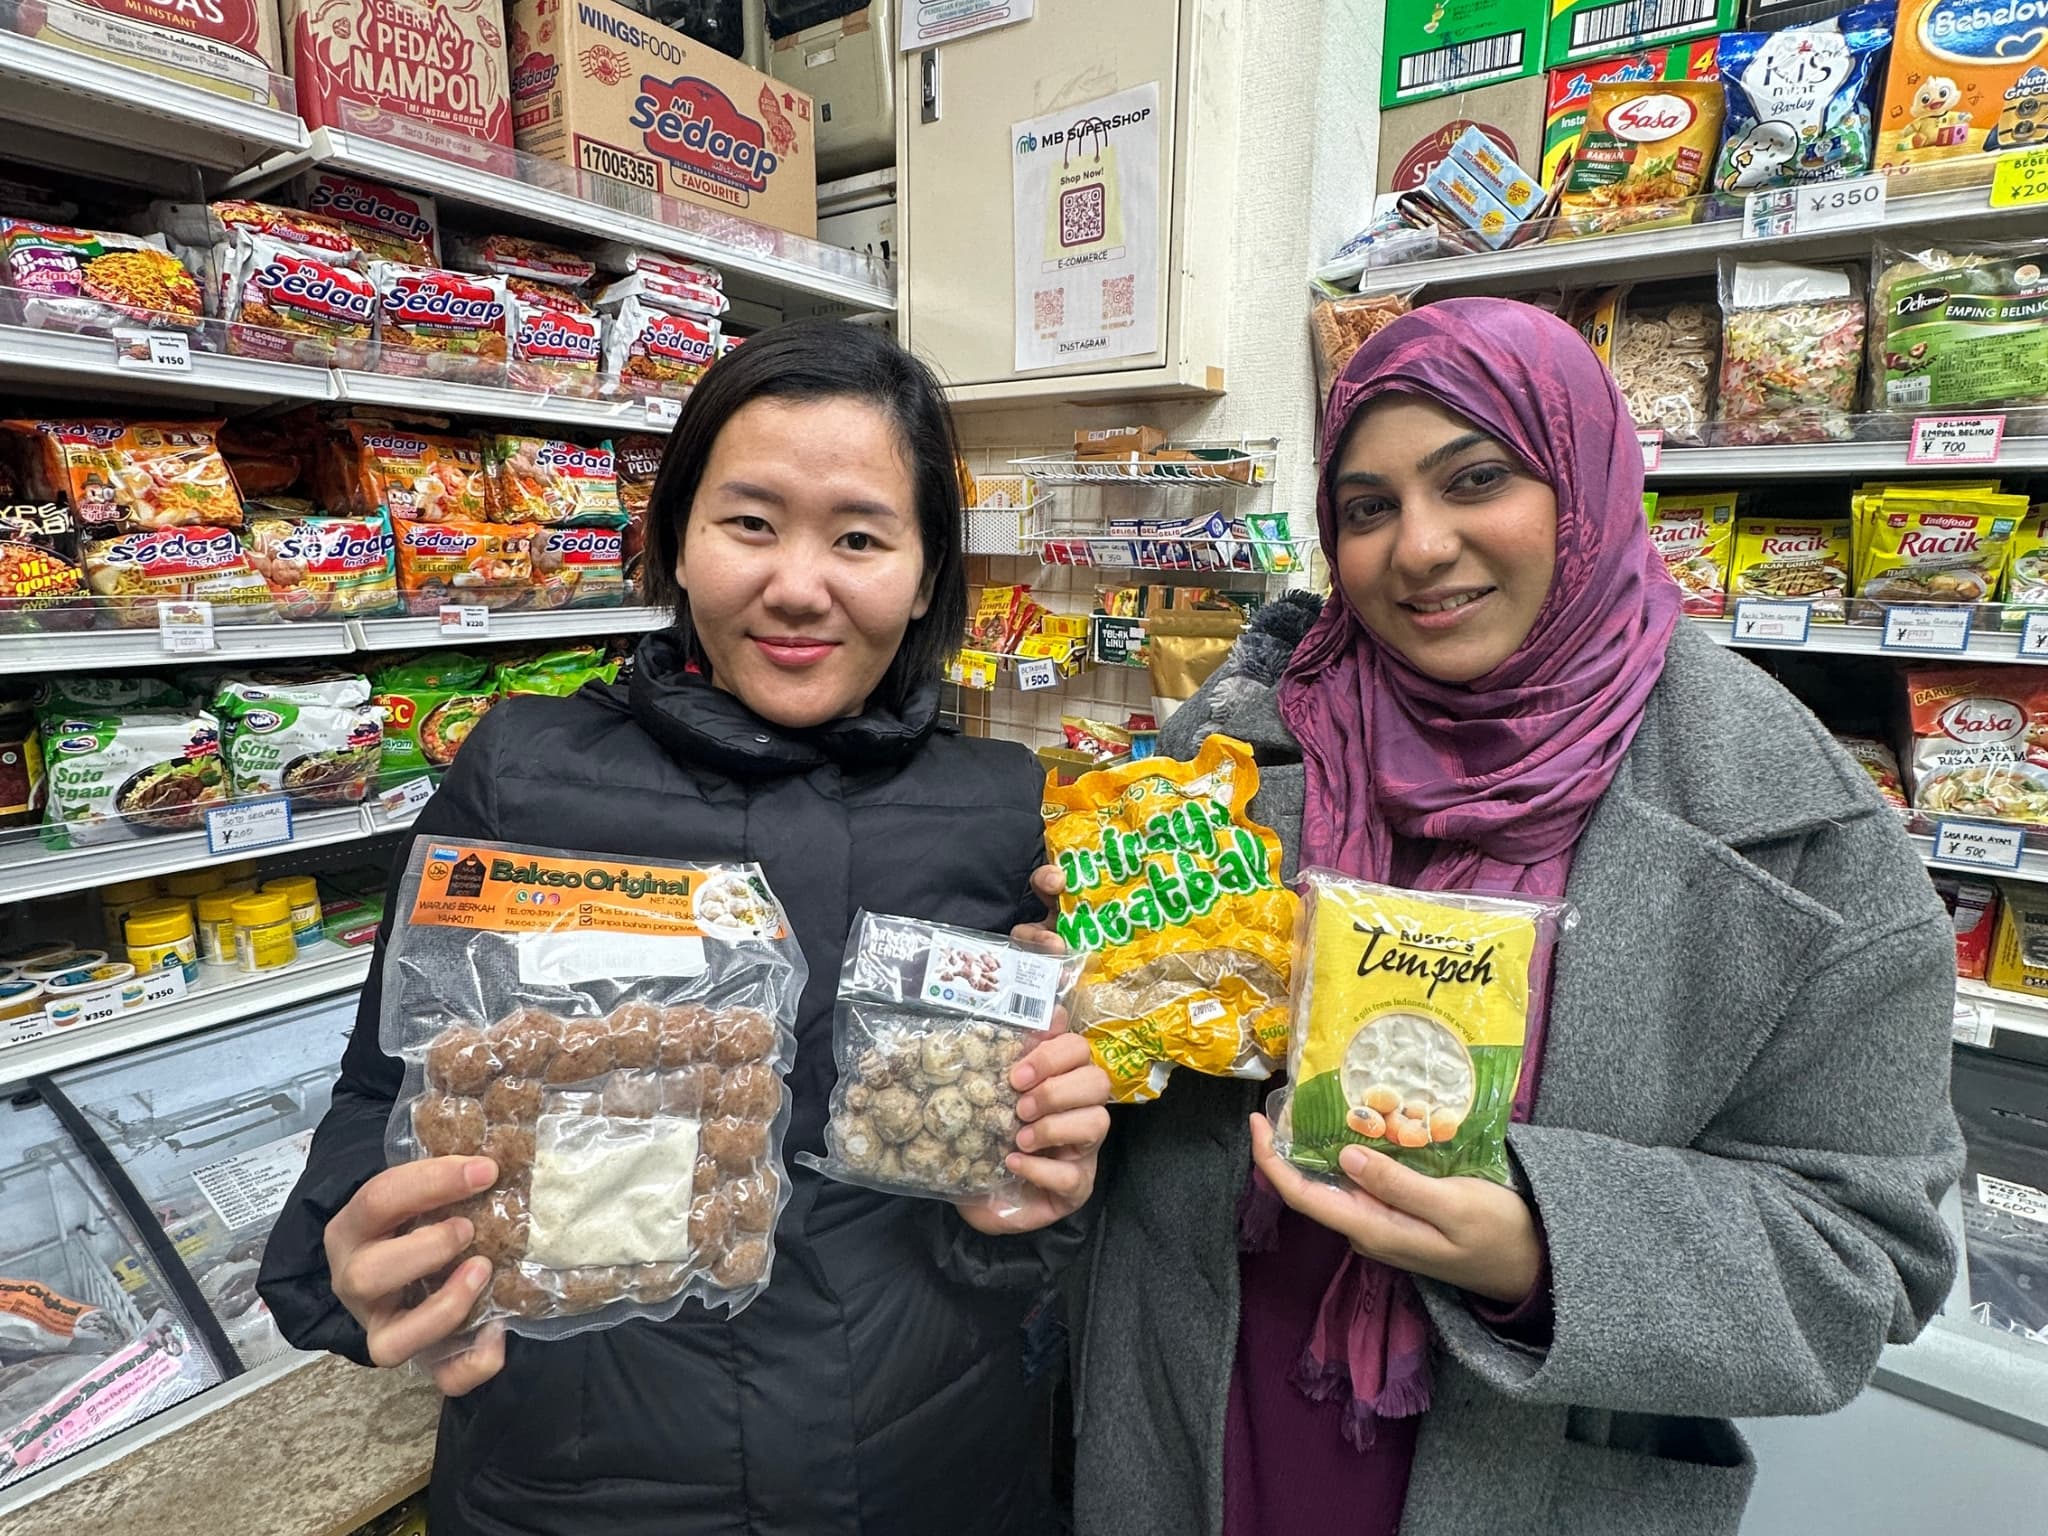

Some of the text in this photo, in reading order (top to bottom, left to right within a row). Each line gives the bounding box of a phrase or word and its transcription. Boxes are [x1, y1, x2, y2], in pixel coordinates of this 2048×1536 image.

[125, 0, 198, 29] MI INSTANT
[578, 3, 682, 65] WINGSFOOD
[377, 23, 455, 71] PEDAS
[353, 51, 485, 116] NAMPOL
[409, 104, 484, 127] MI INSTAN GORENG
[671, 97, 693, 117] Mi
[1618, 99, 1681, 131] Sasa
[1771, 97, 1815, 116] Barley
[630, 94, 778, 180] Sedaap
[1042, 132, 1064, 148] MB
[1586, 151, 1625, 160] BAKWAN
[2015, 158, 2048, 169] BEBE
[583, 143, 654, 188] 17005355
[1060, 167, 1105, 186] Shop Now!
[344, 186, 361, 197] Mi
[681, 173, 741, 203] FAVOURITE
[2011, 182, 2048, 200] ¥20
[311, 184, 432, 236] Sedaap
[1057, 251, 1109, 269] E-COMMERCE
[299, 266, 318, 280] Mi
[420, 283, 437, 295] Mi
[383, 284, 504, 329] Sedaap
[1945, 305, 1998, 319] EMPING
[541, 321, 554, 331] Mi
[642, 324, 715, 360] Sedaap
[1059, 338, 1107, 353] INSTAGRAM
[157, 355, 184, 366] ¥150
[362, 434, 428, 453] Sedaap
[1942, 441, 1966, 453] 700
[1924, 516, 1974, 528] Indofood
[278, 532, 394, 561] Sedaap
[403, 532, 477, 550] Sedaap
[1761, 537, 1830, 555] Racik
[1897, 531, 1983, 557] Racik
[1759, 560, 1783, 569] IKAN
[1031, 674, 1050, 686] 500
[1915, 686, 1953, 705] BARU!
[1954, 704, 2015, 734] Sasa
[238, 739, 280, 760] Soto
[1937, 751, 2027, 766] RASA AYAM
[57, 767, 104, 784] Soto
[1965, 846, 1986, 858] 500
[489, 858, 584, 891] Bakso
[583, 872, 690, 900] Original
[457, 902, 496, 914] BERKAH
[594, 918, 621, 928] tanpa
[1353, 920, 1497, 999] Tempeh
[147, 987, 174, 1001] ¥350
[84, 1008, 113, 1022] ¥350
[1373, 1000, 1393, 1012] from
[1434, 1006, 1443, 1015] to
